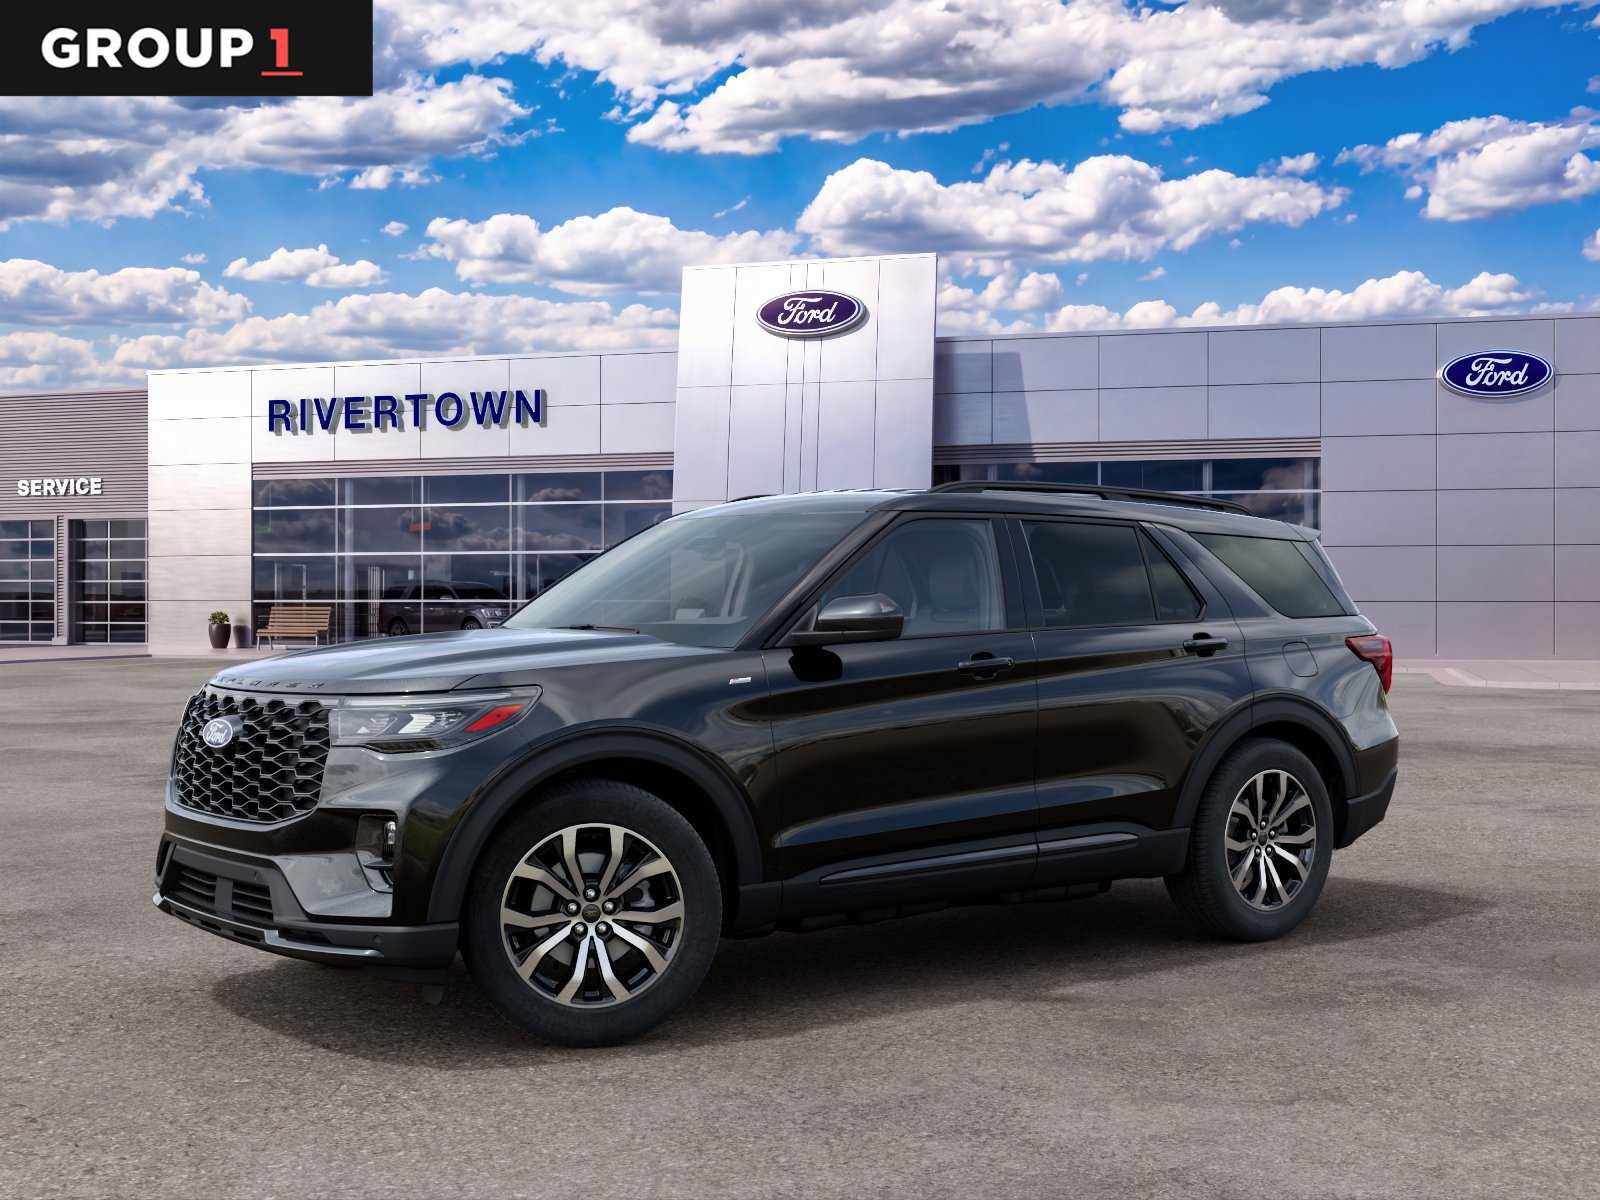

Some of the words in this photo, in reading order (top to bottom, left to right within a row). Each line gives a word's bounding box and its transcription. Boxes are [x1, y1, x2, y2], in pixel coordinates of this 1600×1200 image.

[777, 297, 839, 325] Ford
[1465, 357, 1530, 386] Ford
[268, 388, 543, 433] RIVERTOWN
[17, 477, 103, 497] SERVICE
[205, 722, 229, 744] Ford
